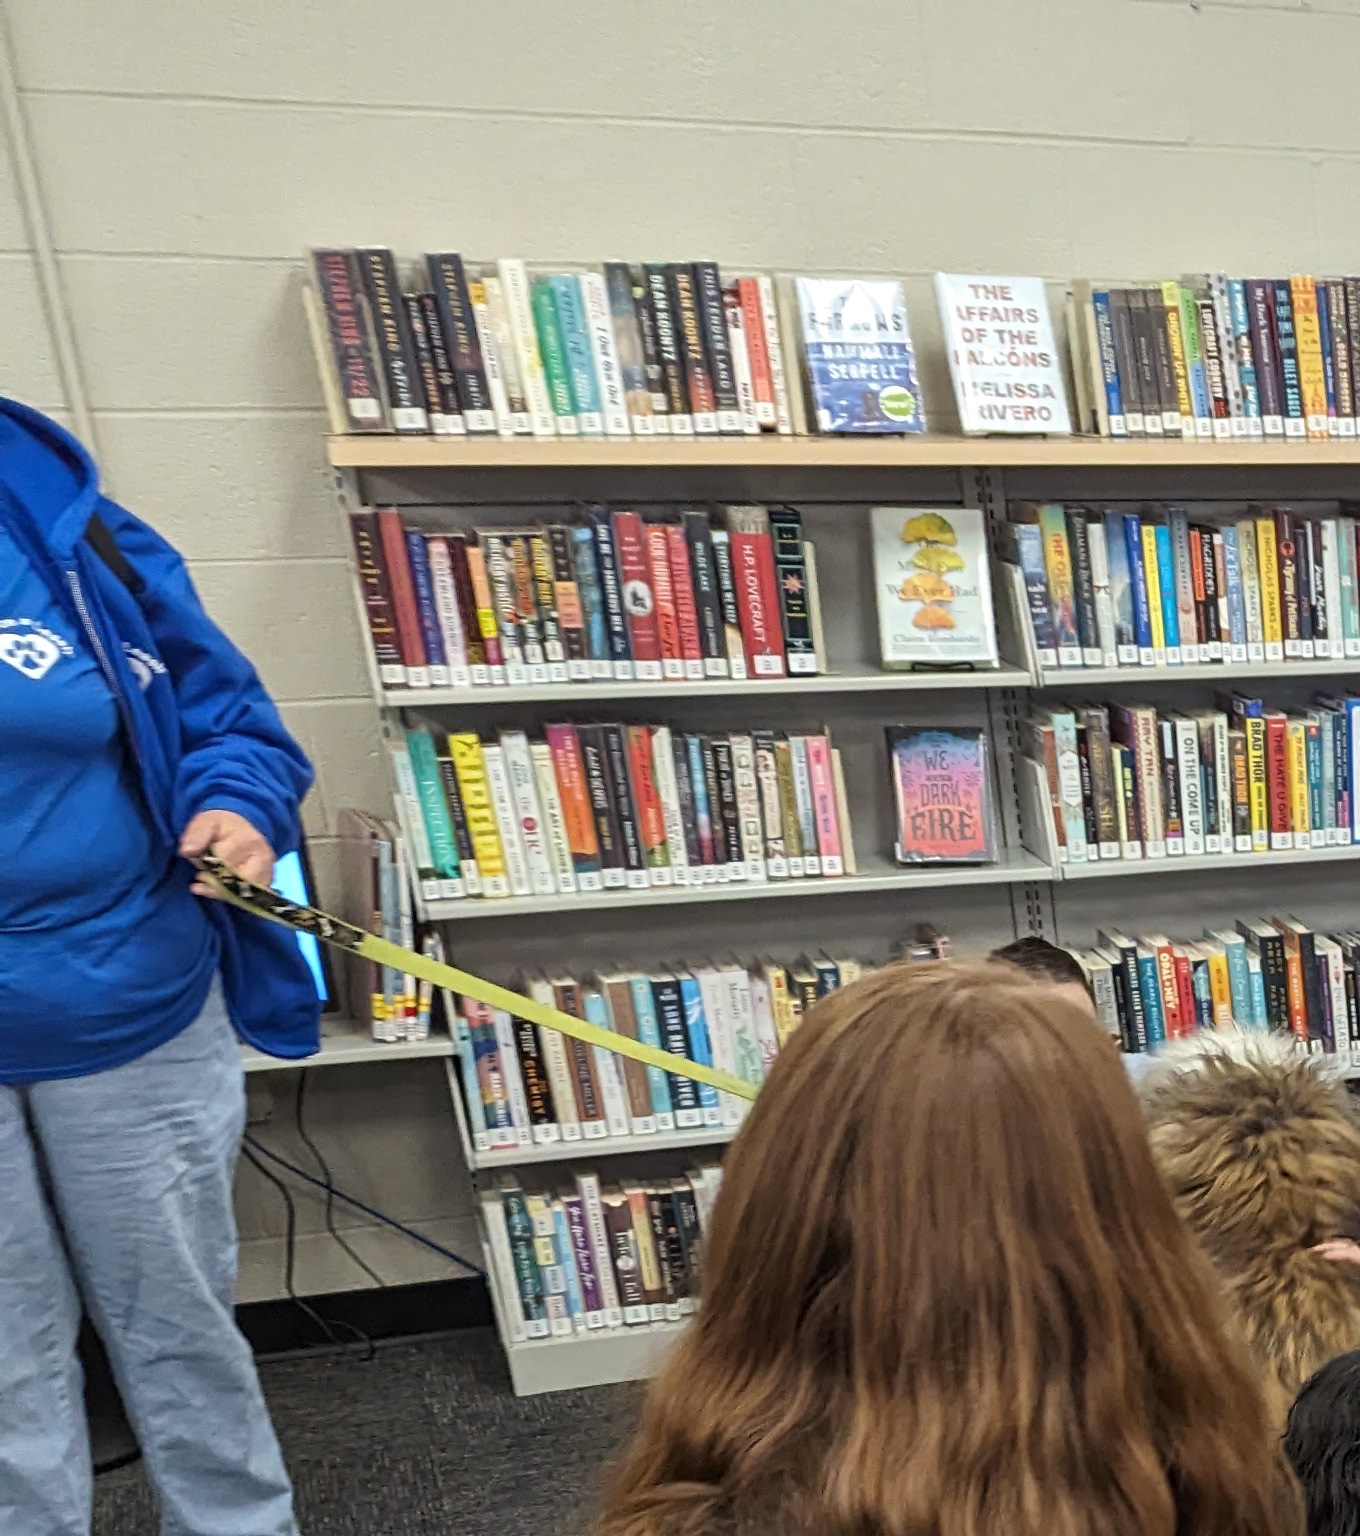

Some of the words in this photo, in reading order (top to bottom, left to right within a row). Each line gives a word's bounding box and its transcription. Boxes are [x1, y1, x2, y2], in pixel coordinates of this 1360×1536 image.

[649, 274, 668, 309] DEAN
[676, 274, 693, 308] DEAN
[704, 268, 719, 295] THIS
[968, 284, 1014, 302] THE
[1254, 288, 1264, 301] My
[369, 255, 394, 314] STEPHEN
[382, 319, 400, 352] KING
[441, 263, 464, 317] STEPHEN
[454, 322, 471, 354] KING
[956, 303, 1039, 323] AFFAIRS
[1256, 303, 1266, 326] Dark
[655, 311, 676, 361] KOONTZ
[681, 311, 701, 360] KOONTZ
[708, 301, 724, 350] TENDER
[961, 327, 988, 344] OF
[995, 329, 1038, 346] THE
[1202, 308, 1216, 358] LOVECRAFT
[1260, 328, 1271, 363] Vanessa
[1335, 342, 1347, 369] GOLD
[715, 354, 729, 390] LAND
[828, 363, 901, 380] SERPELL
[1175, 361, 1185, 376] UP
[1207, 358, 1223, 399] COUNTRY
[1283, 358, 1297, 385] RILEY
[962, 382, 1056, 399] MELISSA
[1177, 378, 1190, 411] WHITE
[1286, 388, 1300, 417] SAGER
[1339, 372, 1350, 413] DIGGERS
[978, 403, 1052, 422] RIVERO
[597, 524, 609, 542] SAVE
[1051, 532, 1064, 557] THE
[601, 544, 611, 555] ME
[694, 542, 706, 568] WILDE
[742, 545, 755, 567] H.P.
[1245, 530, 1255, 581] NICHOLAS
[1264, 537, 1275, 588] NICHOLAS
[698, 570, 710, 592] LAKE
[716, 545, 733, 590] EVERYTHING
[1227, 564, 1239, 587] Talk
[603, 570, 619, 613] DANGEROUS
[723, 592, 733, 603] WE
[1078, 570, 1090, 599] BLACK
[724, 605, 736, 623] KEEP
[744, 569, 765, 643] LOVECRAFT
[1248, 585, 1257, 618] SPARKS
[1267, 590, 1277, 623] SPARKS
[611, 615, 621, 632] MEN
[1141, 717, 1150, 745] AMY
[1251, 721, 1263, 751] BRAD
[1274, 733, 1283, 755] THE
[1184, 737, 1195, 755] ON
[924, 750, 950, 771] WE
[1144, 750, 1154, 777] TAN
[1185, 758, 1196, 780] THE
[1234, 755, 1245, 778] BRAD
[1253, 755, 1265, 783] THOR
[1275, 759, 1285, 788] HATE
[919, 782, 961, 806] DARK
[1186, 783, 1198, 816] COME
[1236, 780, 1247, 803] THOR
[1276, 792, 1286, 800] U
[910, 808, 977, 842] FIRE
[1189, 820, 1200, 835] UP
[1277, 803, 1287, 831] GIVE
[1159, 952, 1171, 980] OPAL
[1275, 942, 1283, 973] ANDY
[728, 982, 740, 1020] Moriarty
[739, 988, 749, 1014] Liane
[1147, 978, 1156, 1006] DEARLY
[1152, 1008, 1161, 1038] BELOVED
[1163, 987, 1174, 1009] NEV
[1335, 1014, 1347, 1048] GELATO
[582, 1082, 597, 1117] MILLER
